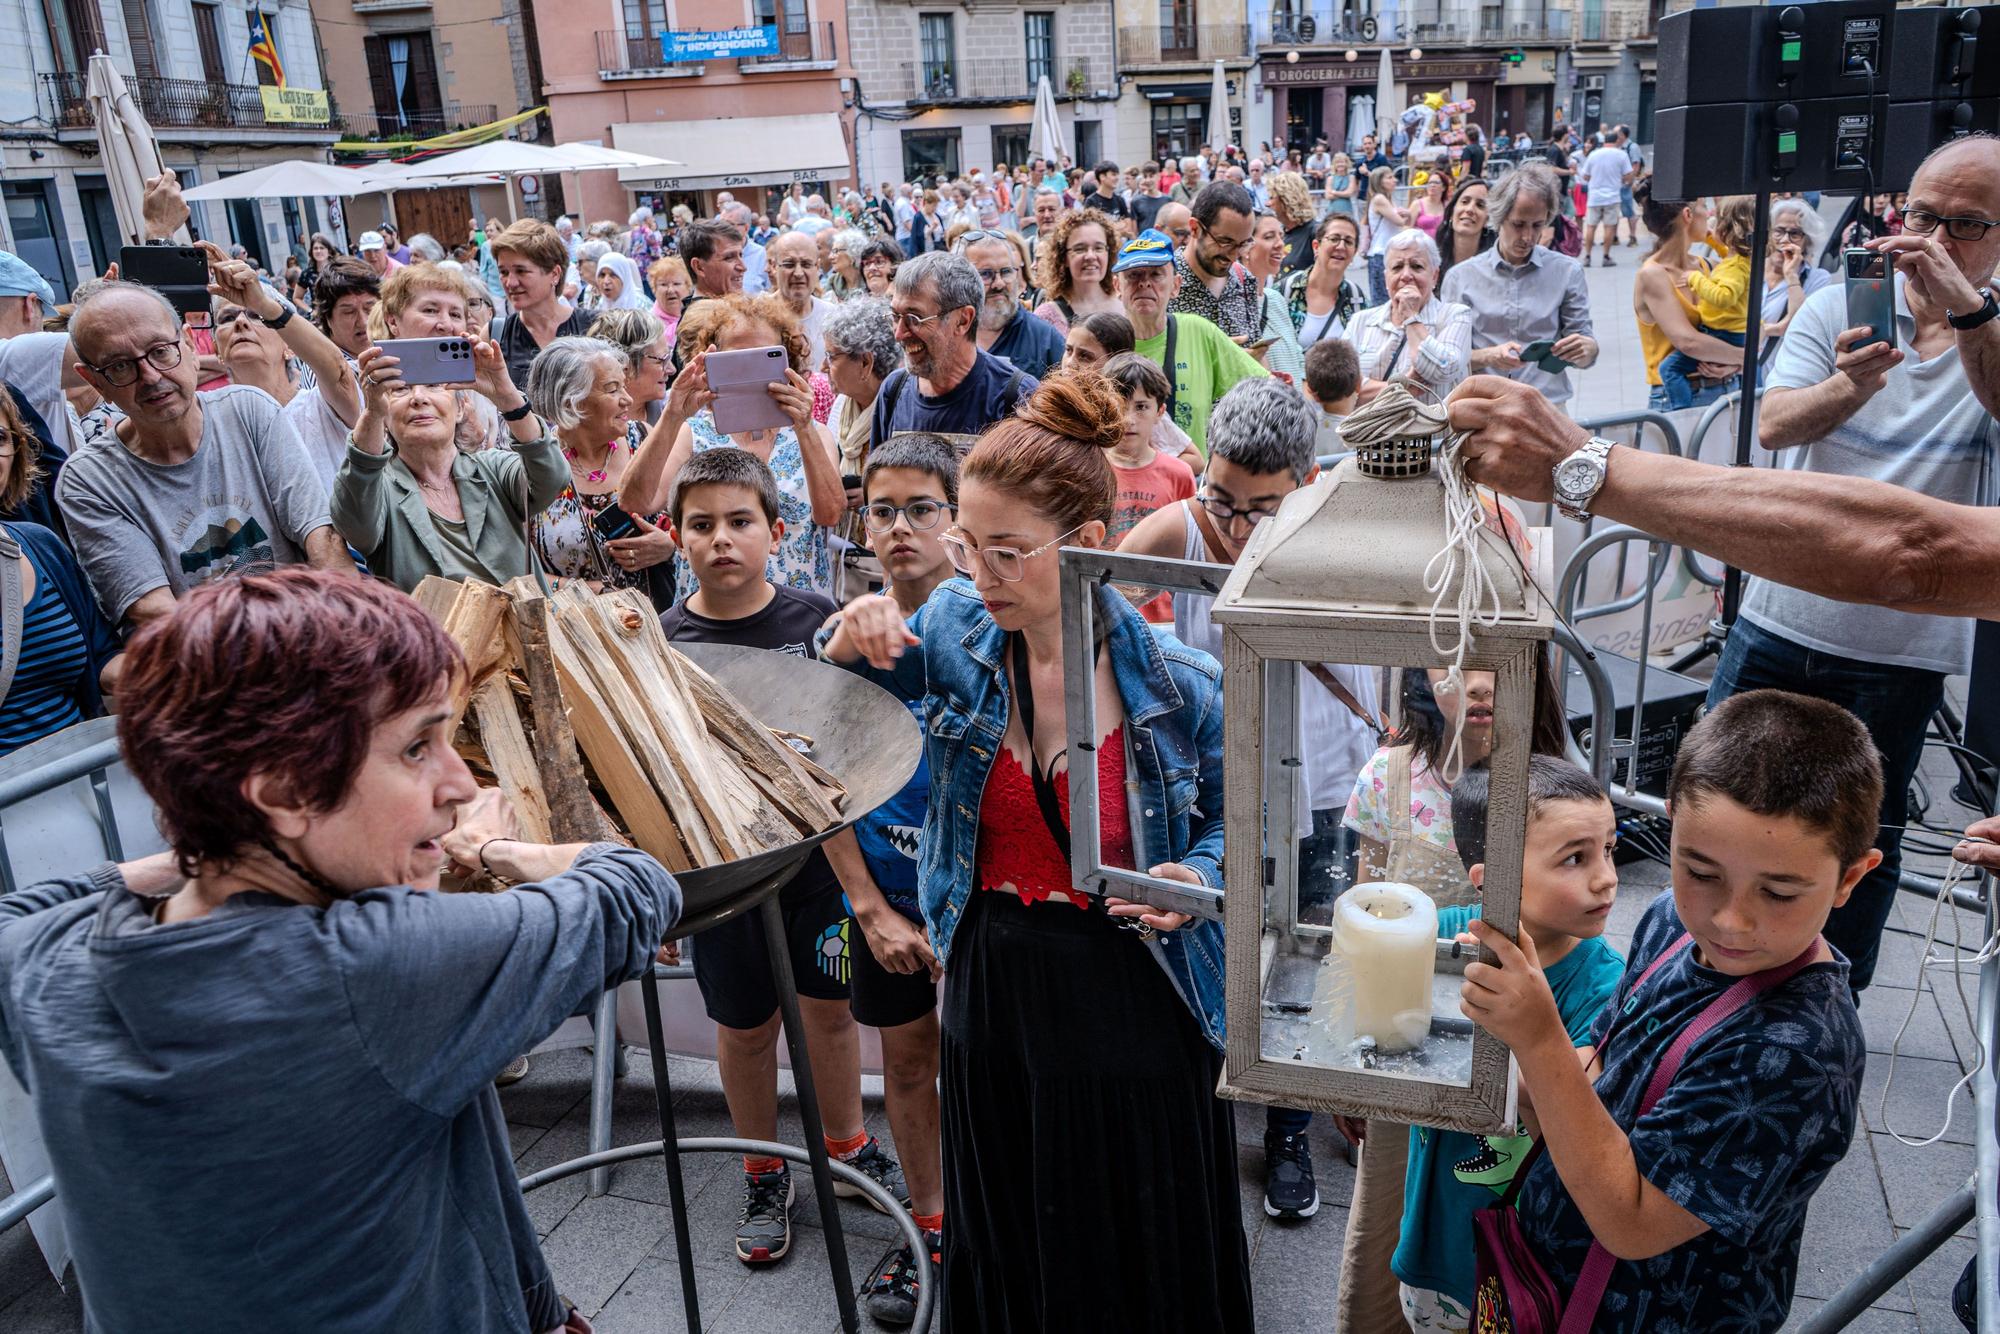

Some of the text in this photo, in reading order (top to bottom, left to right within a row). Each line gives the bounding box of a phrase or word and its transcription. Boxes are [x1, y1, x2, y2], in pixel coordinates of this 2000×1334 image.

[728, 29, 764, 40] FUTUR
[687, 38, 769, 51] INDEPENDENTS
[1350, 67, 1378, 79] FERR
[654, 179, 680, 190] BAR
[794, 171, 818, 181] BAR
